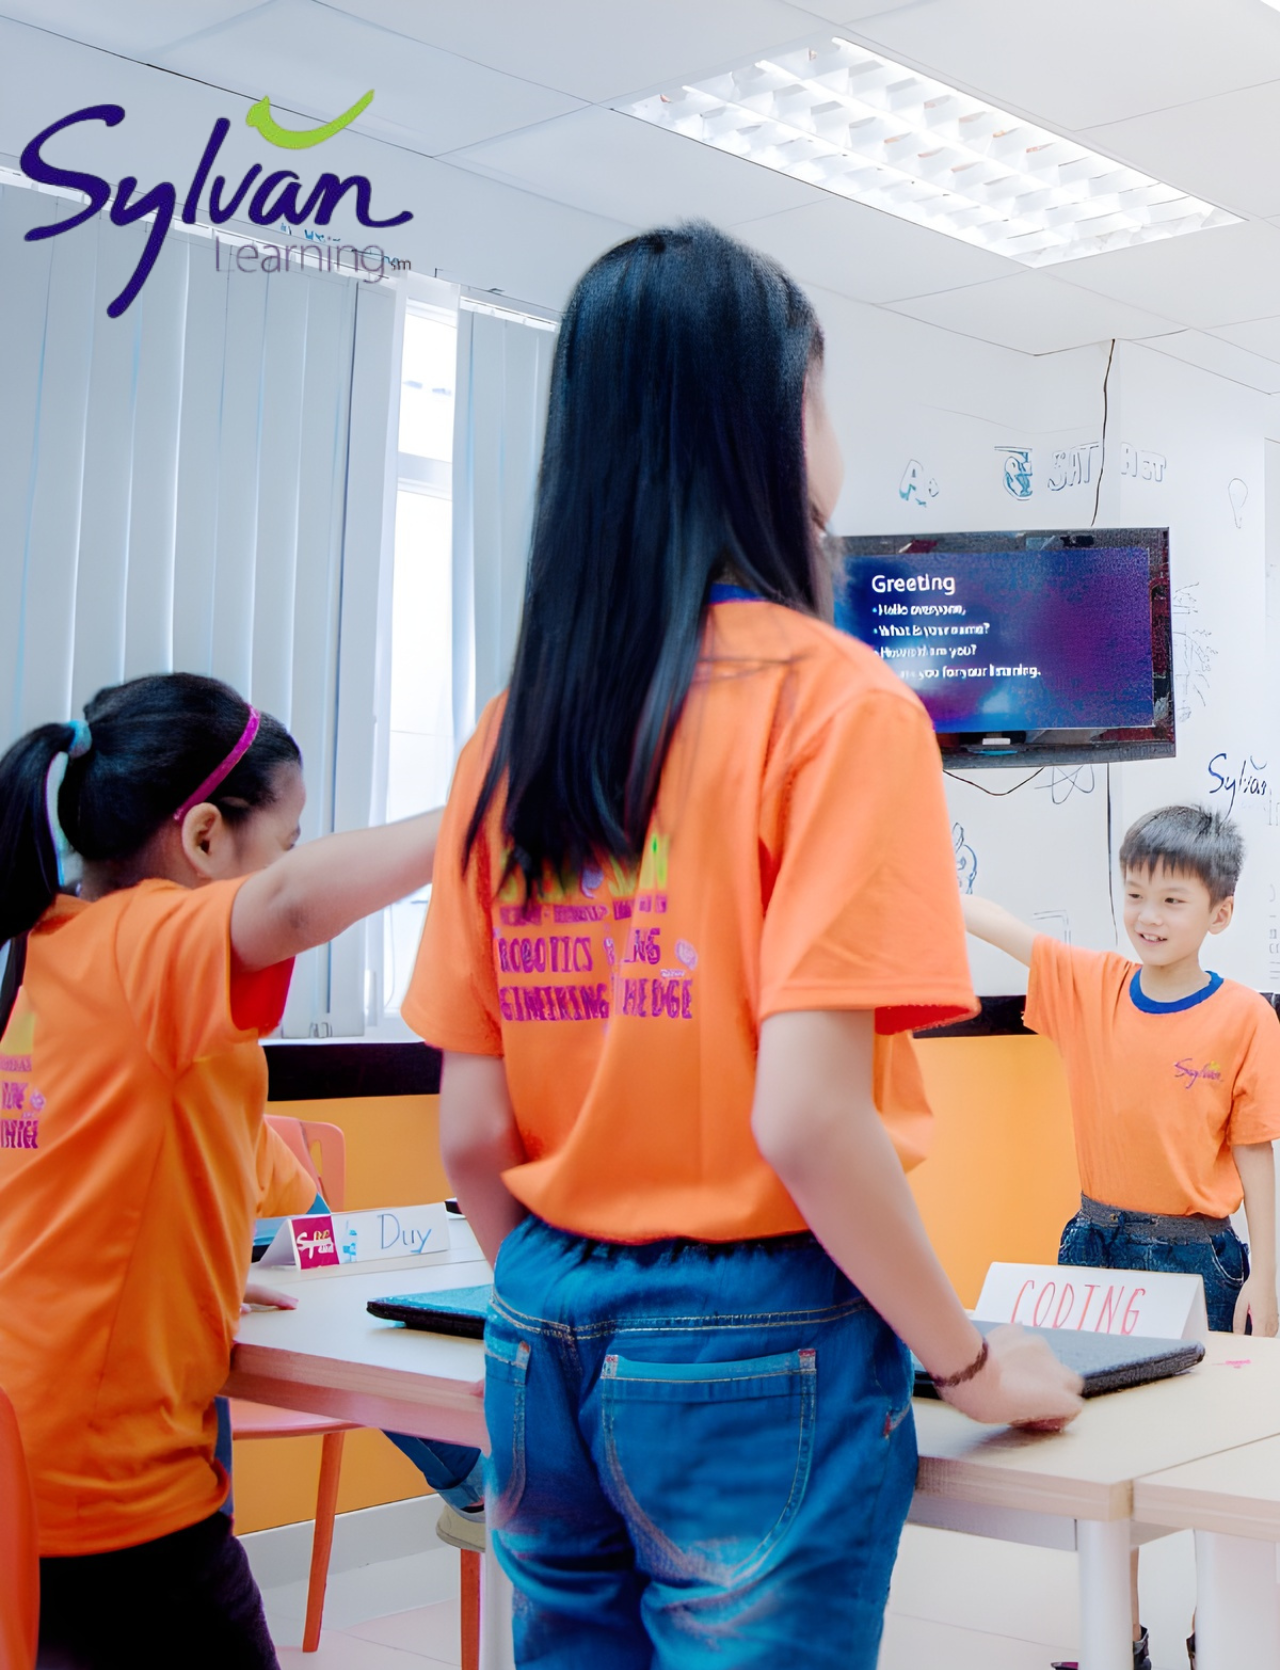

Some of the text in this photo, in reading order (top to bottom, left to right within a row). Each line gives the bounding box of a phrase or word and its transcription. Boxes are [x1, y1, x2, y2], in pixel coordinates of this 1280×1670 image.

[871, 574, 956, 595] Greeting
[377, 1213, 432, 1254] Duy
[1010, 1279, 1146, 1336] CODING
